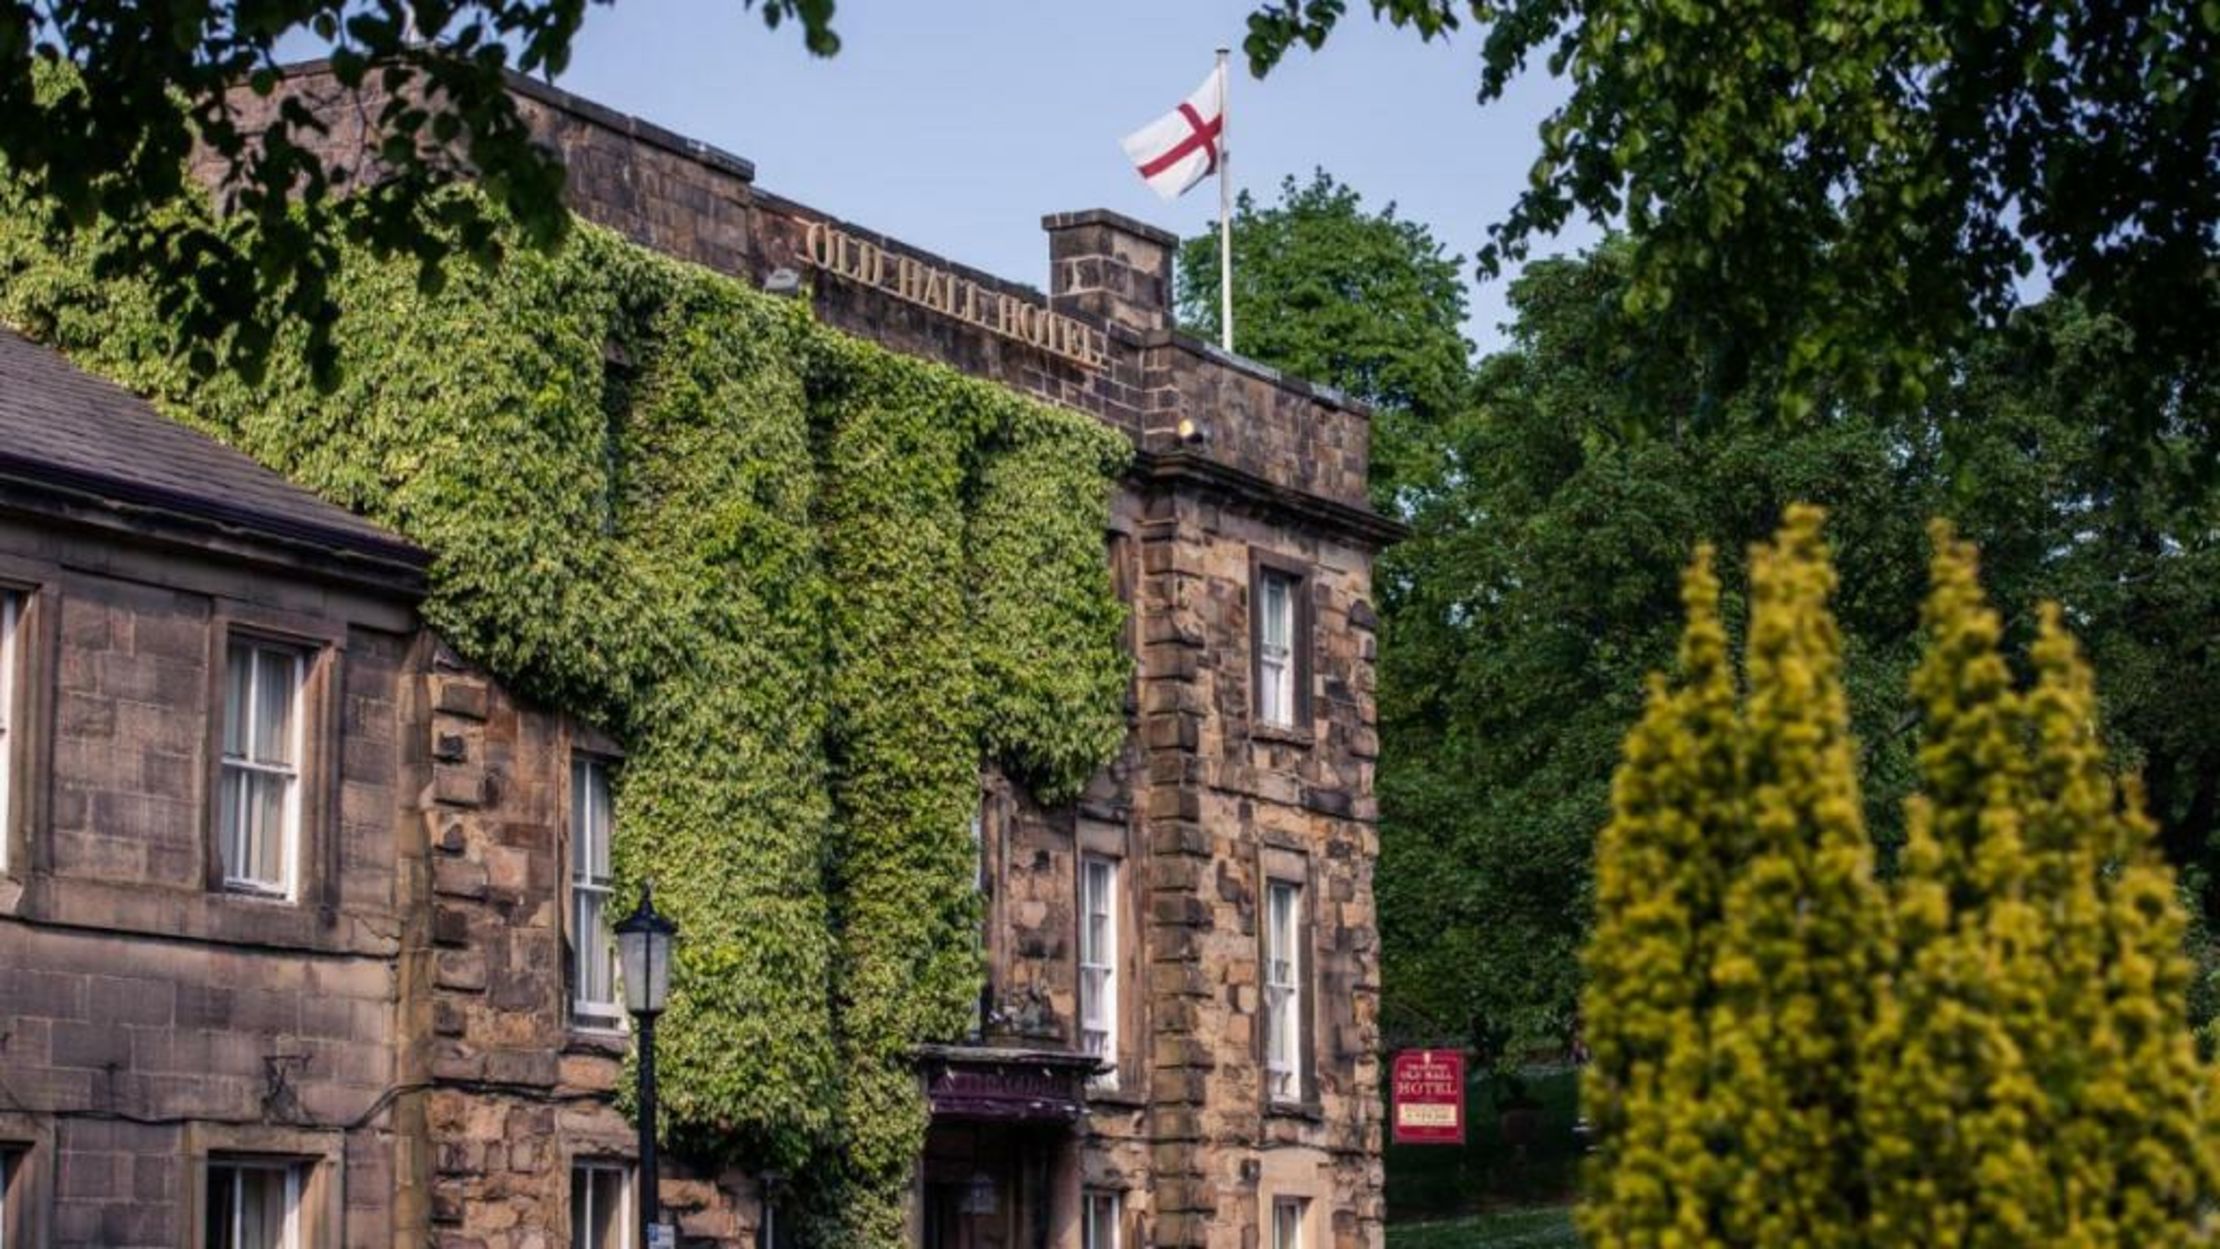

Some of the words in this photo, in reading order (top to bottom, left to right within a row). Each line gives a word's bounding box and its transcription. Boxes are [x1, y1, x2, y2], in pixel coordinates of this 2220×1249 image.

[807, 222, 883, 286] OLD
[898, 256, 986, 326] HALL
[998, 294, 1101, 367] HOTEL
[1398, 1082, 1457, 1095] HOTEL
